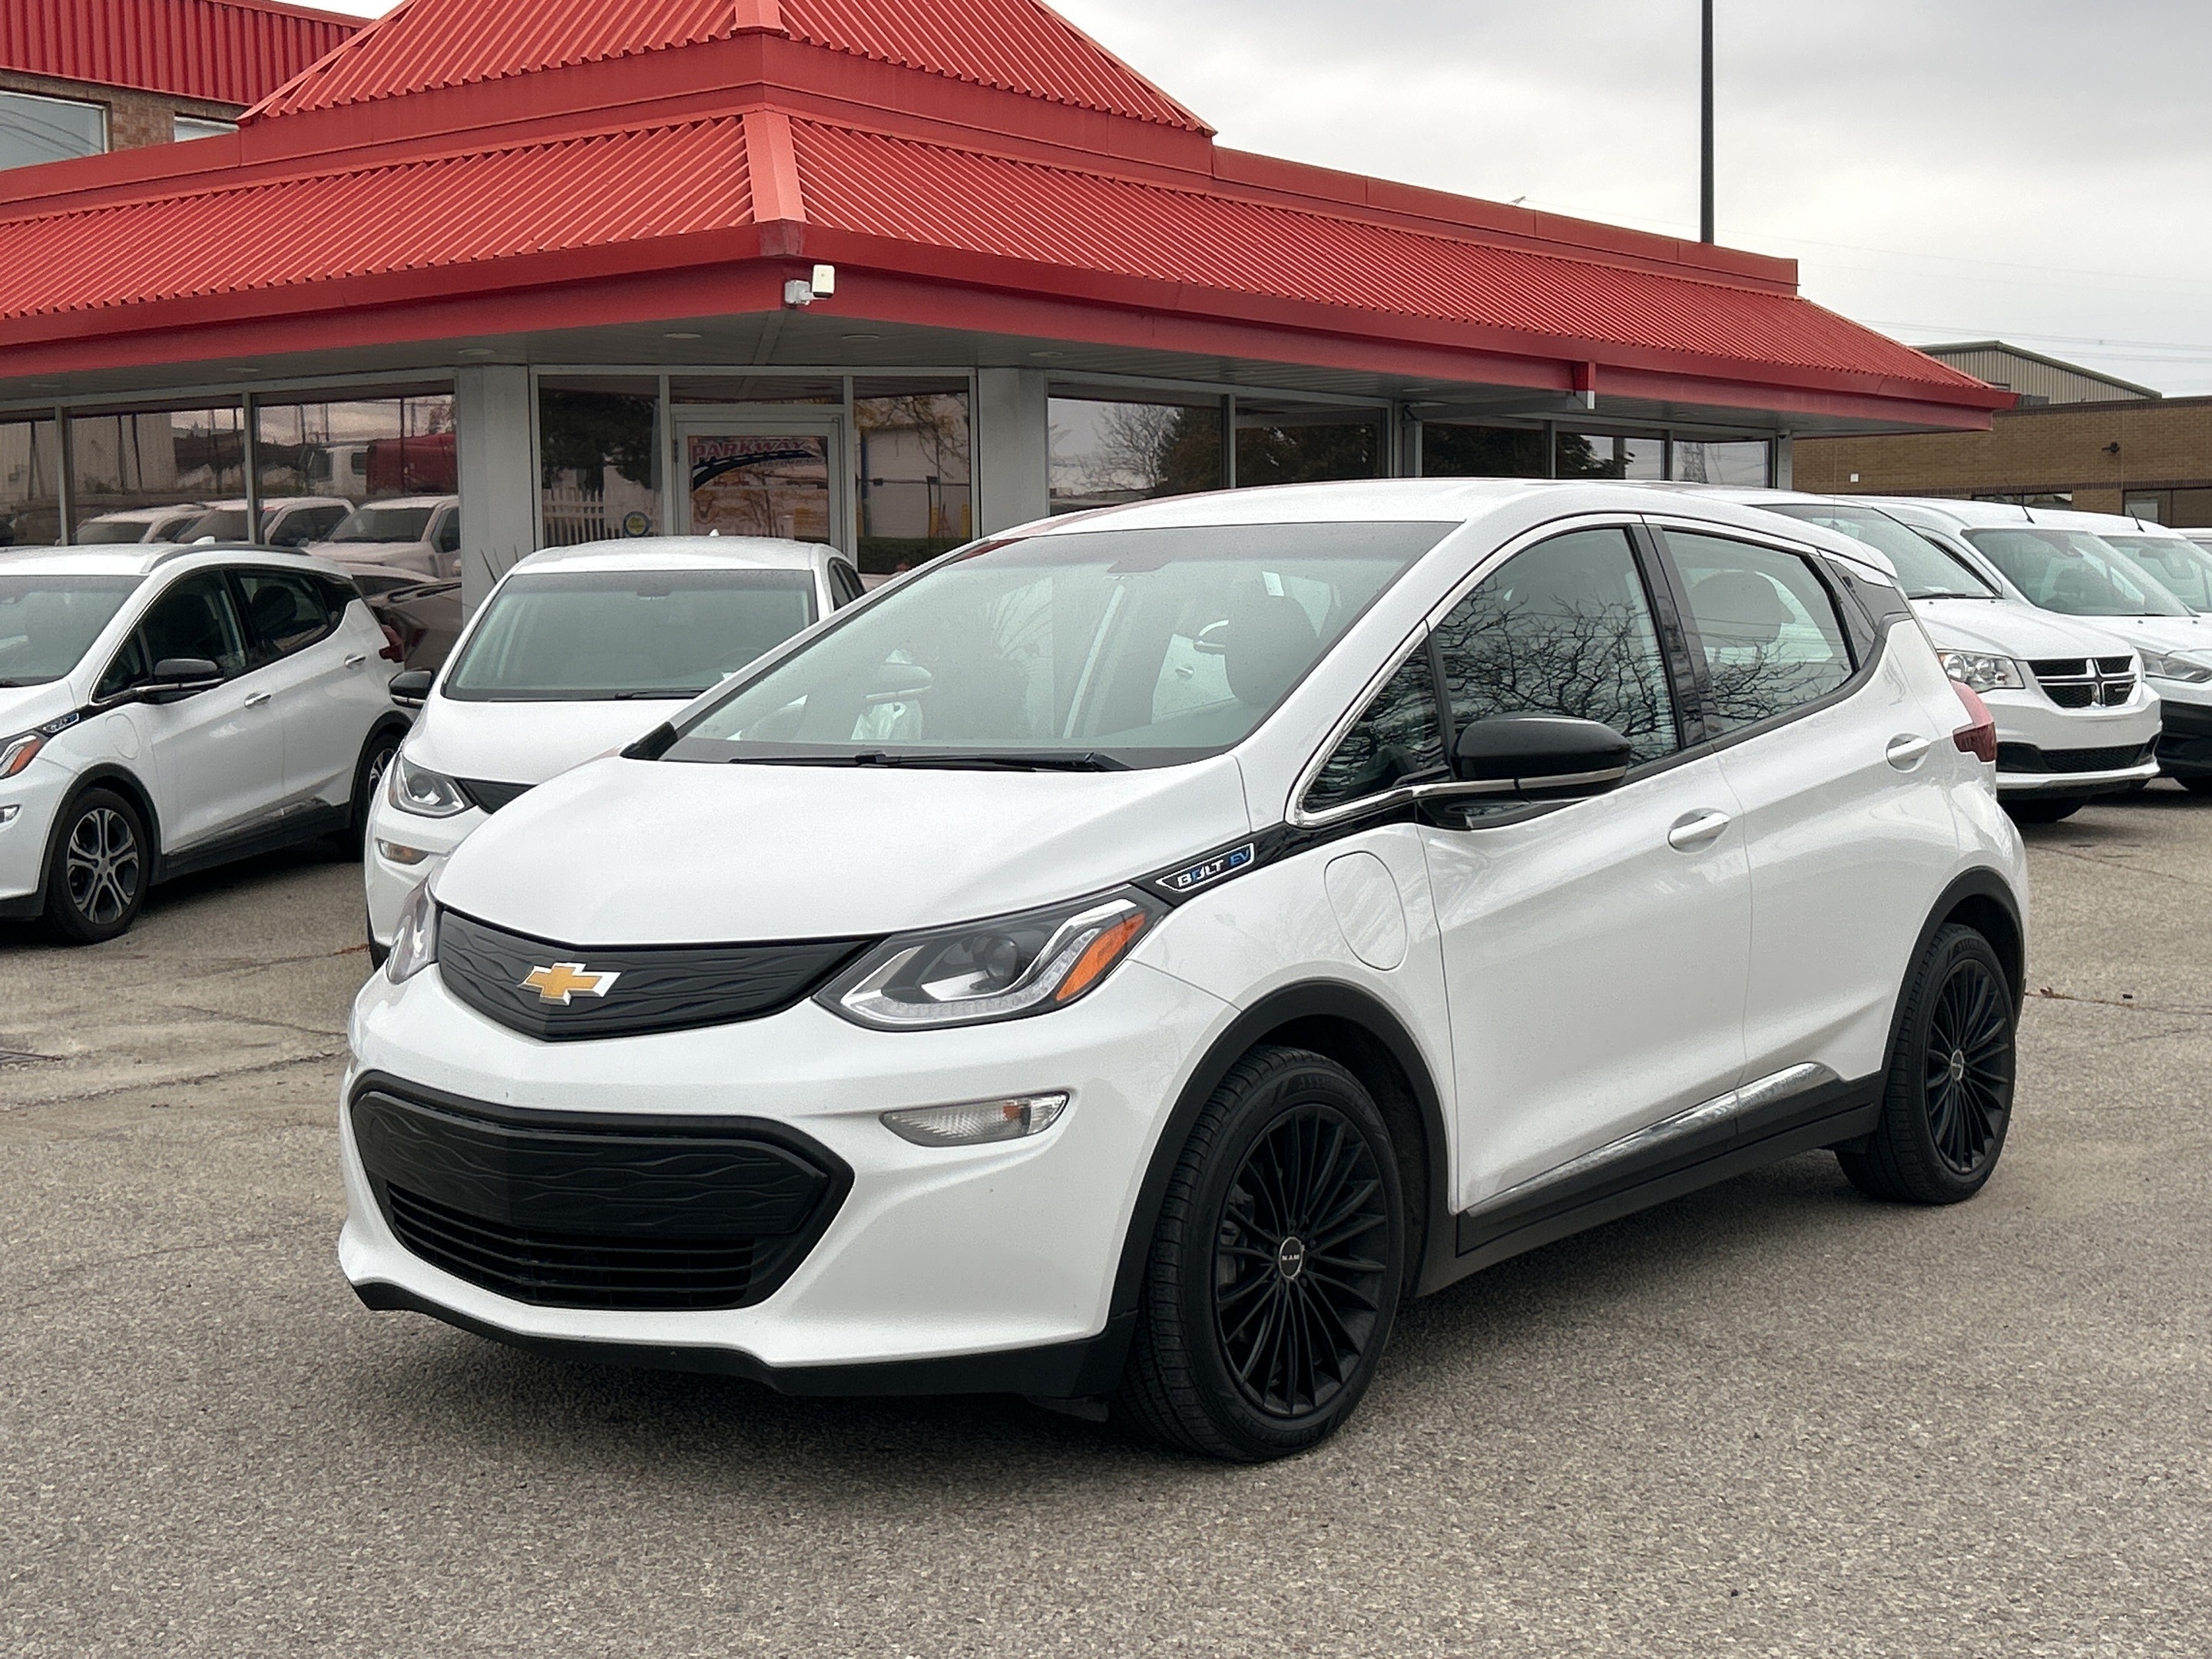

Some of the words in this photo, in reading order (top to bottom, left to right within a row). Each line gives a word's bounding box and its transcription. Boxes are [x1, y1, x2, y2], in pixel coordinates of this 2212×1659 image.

[692, 440, 805, 463] PARKWAY
[1177, 859, 1224, 887] BOLT
[1230, 849, 1250, 866] EV
